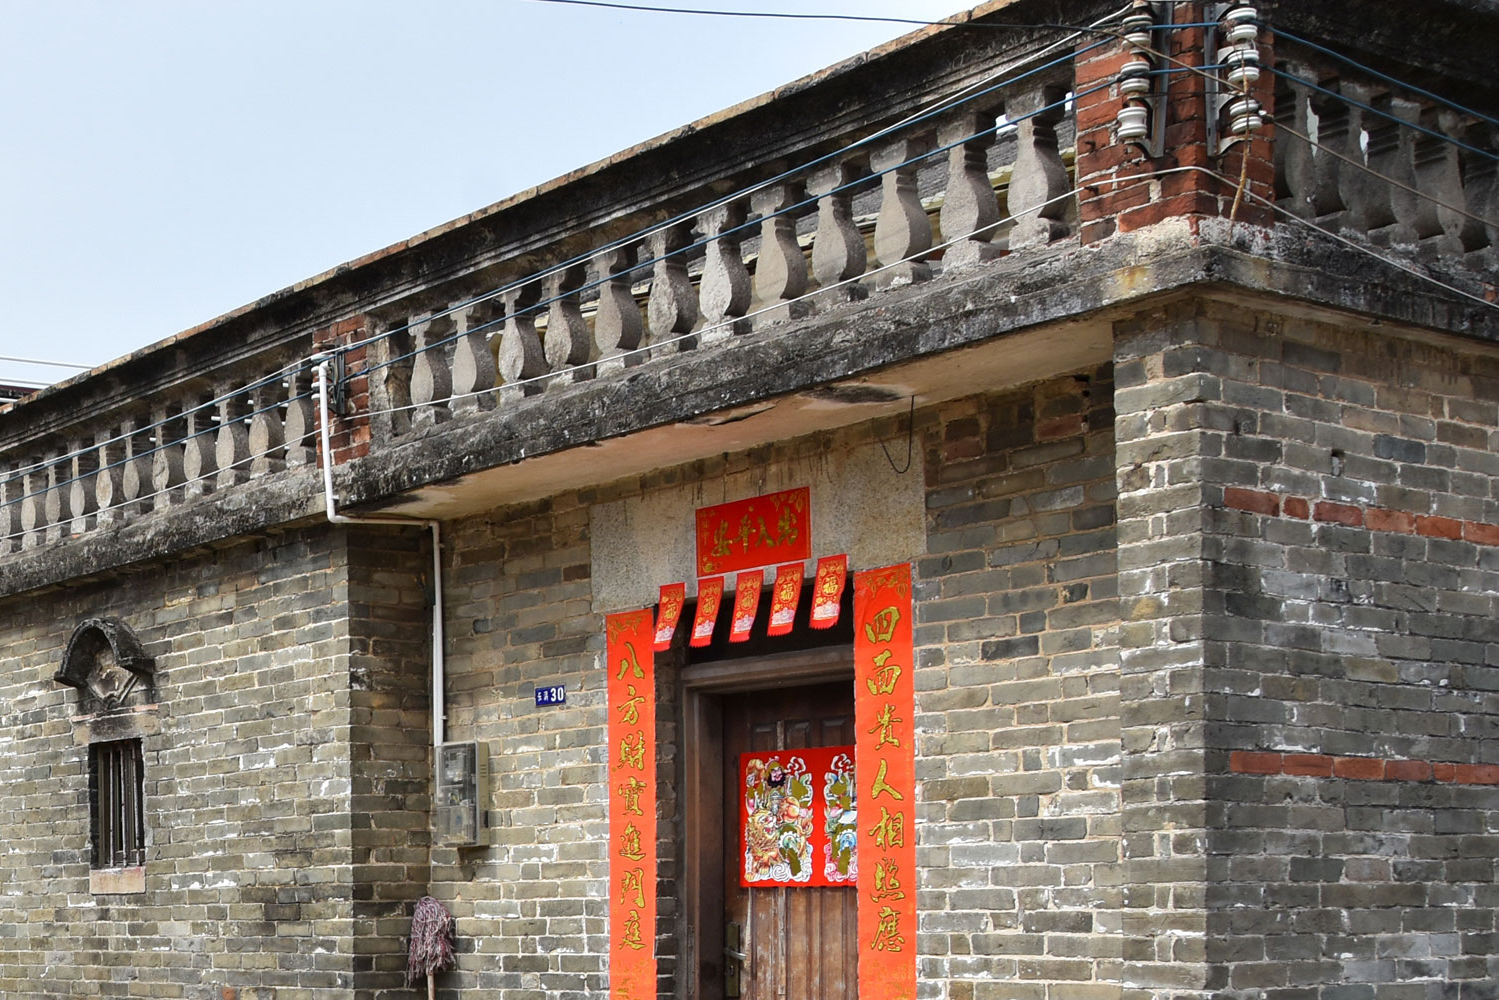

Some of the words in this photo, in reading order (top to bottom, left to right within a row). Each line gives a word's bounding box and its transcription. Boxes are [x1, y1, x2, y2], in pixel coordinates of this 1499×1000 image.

[550, 686, 564, 702] 30
[616, 641, 647, 951] 八方財寶進門庭
[864, 606, 906, 952] 四面貴人相照應
